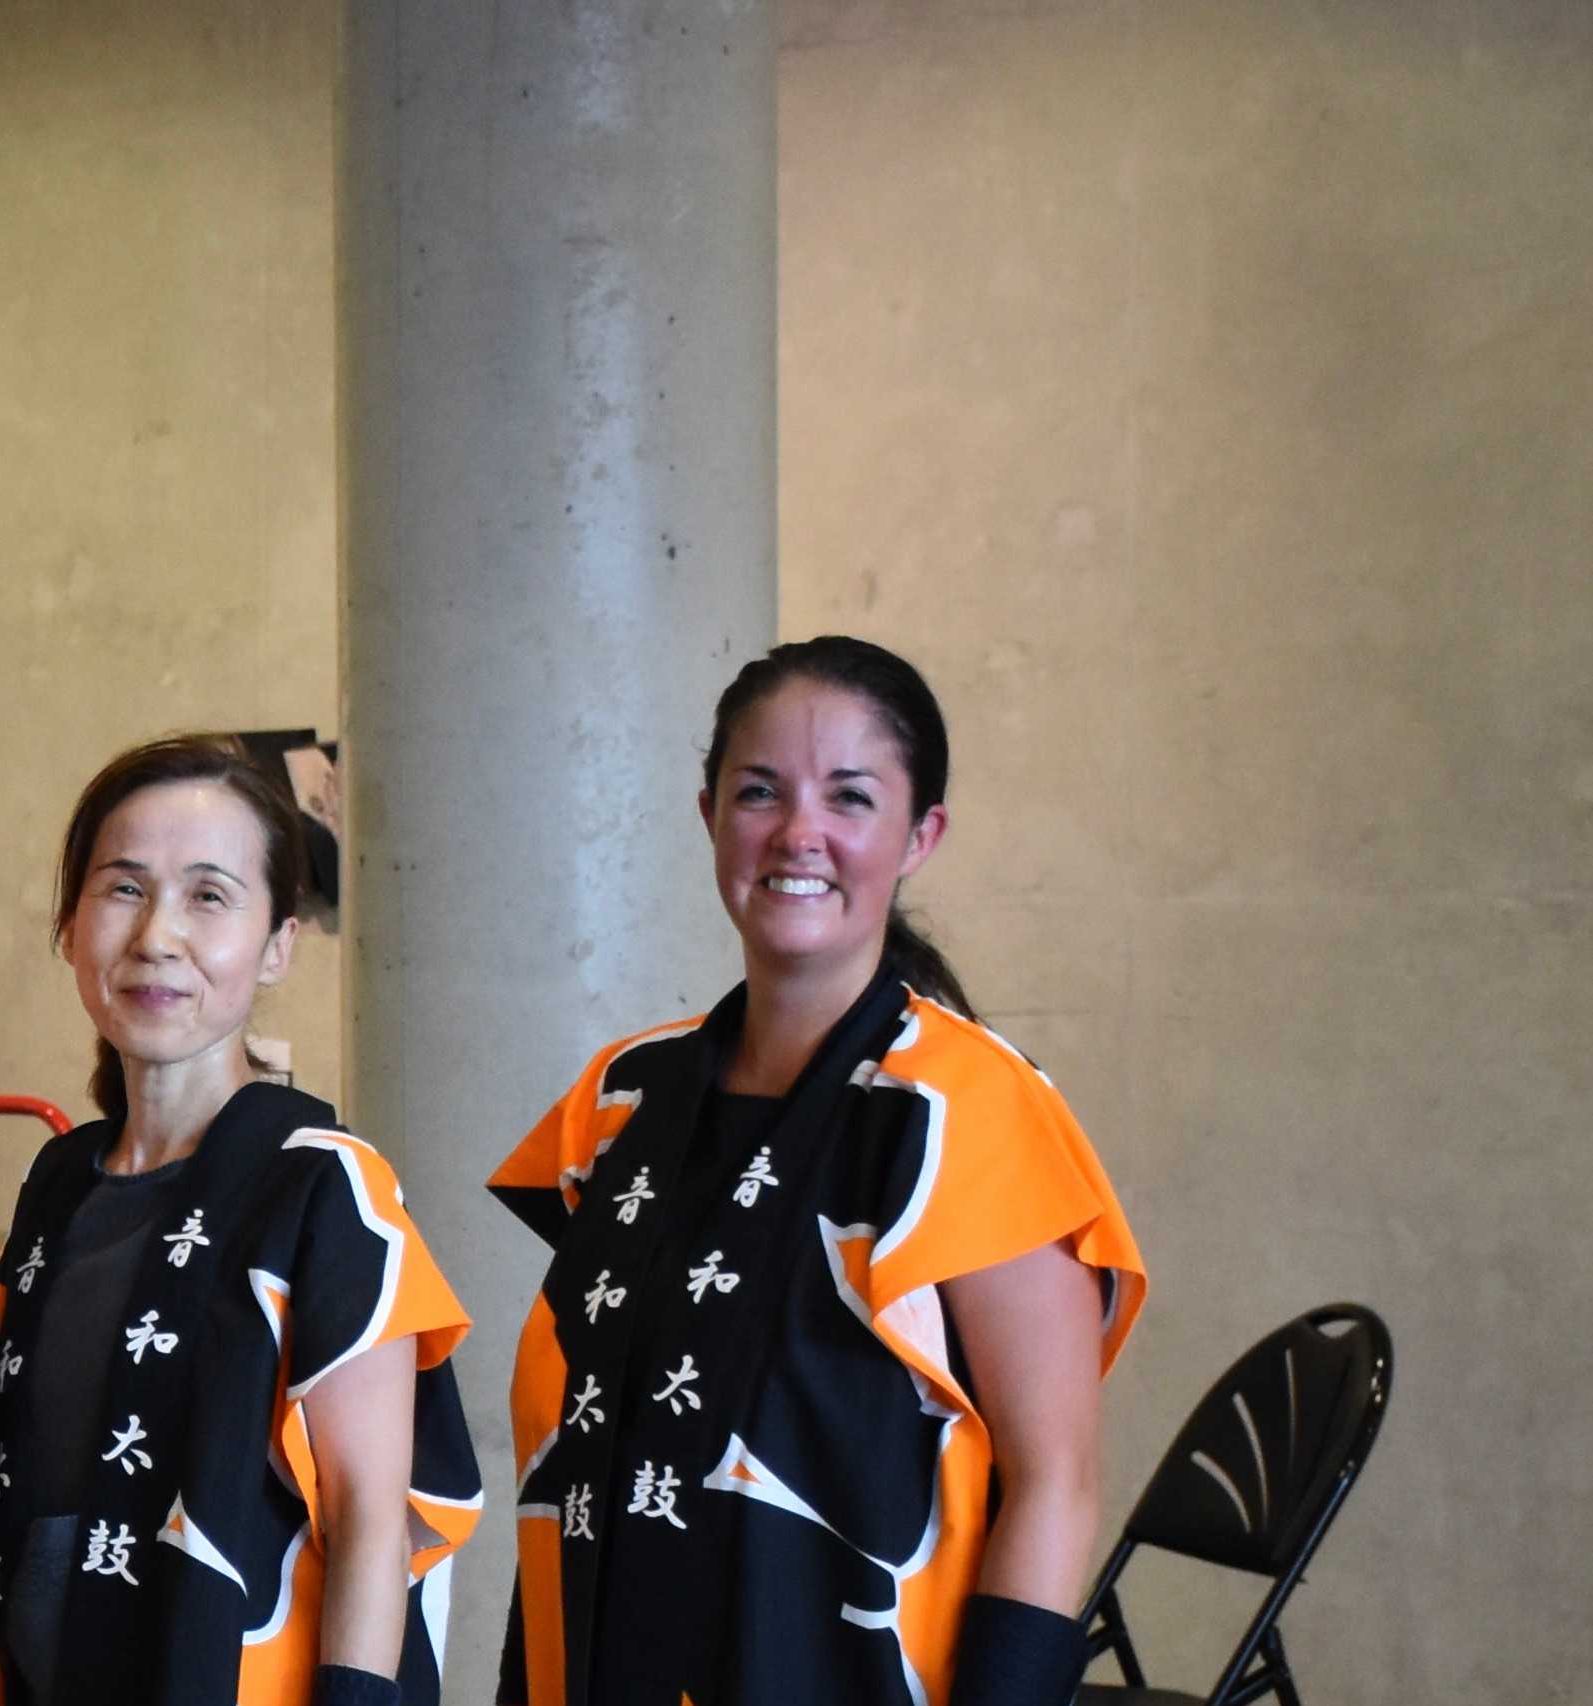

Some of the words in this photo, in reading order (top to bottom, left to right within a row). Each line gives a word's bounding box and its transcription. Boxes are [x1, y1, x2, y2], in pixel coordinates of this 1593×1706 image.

[82, 1209, 211, 1587] 音和太鼓
[563, 1166, 656, 1541] 音和太鼓
[627, 1146, 780, 1530] 音和太鼓
